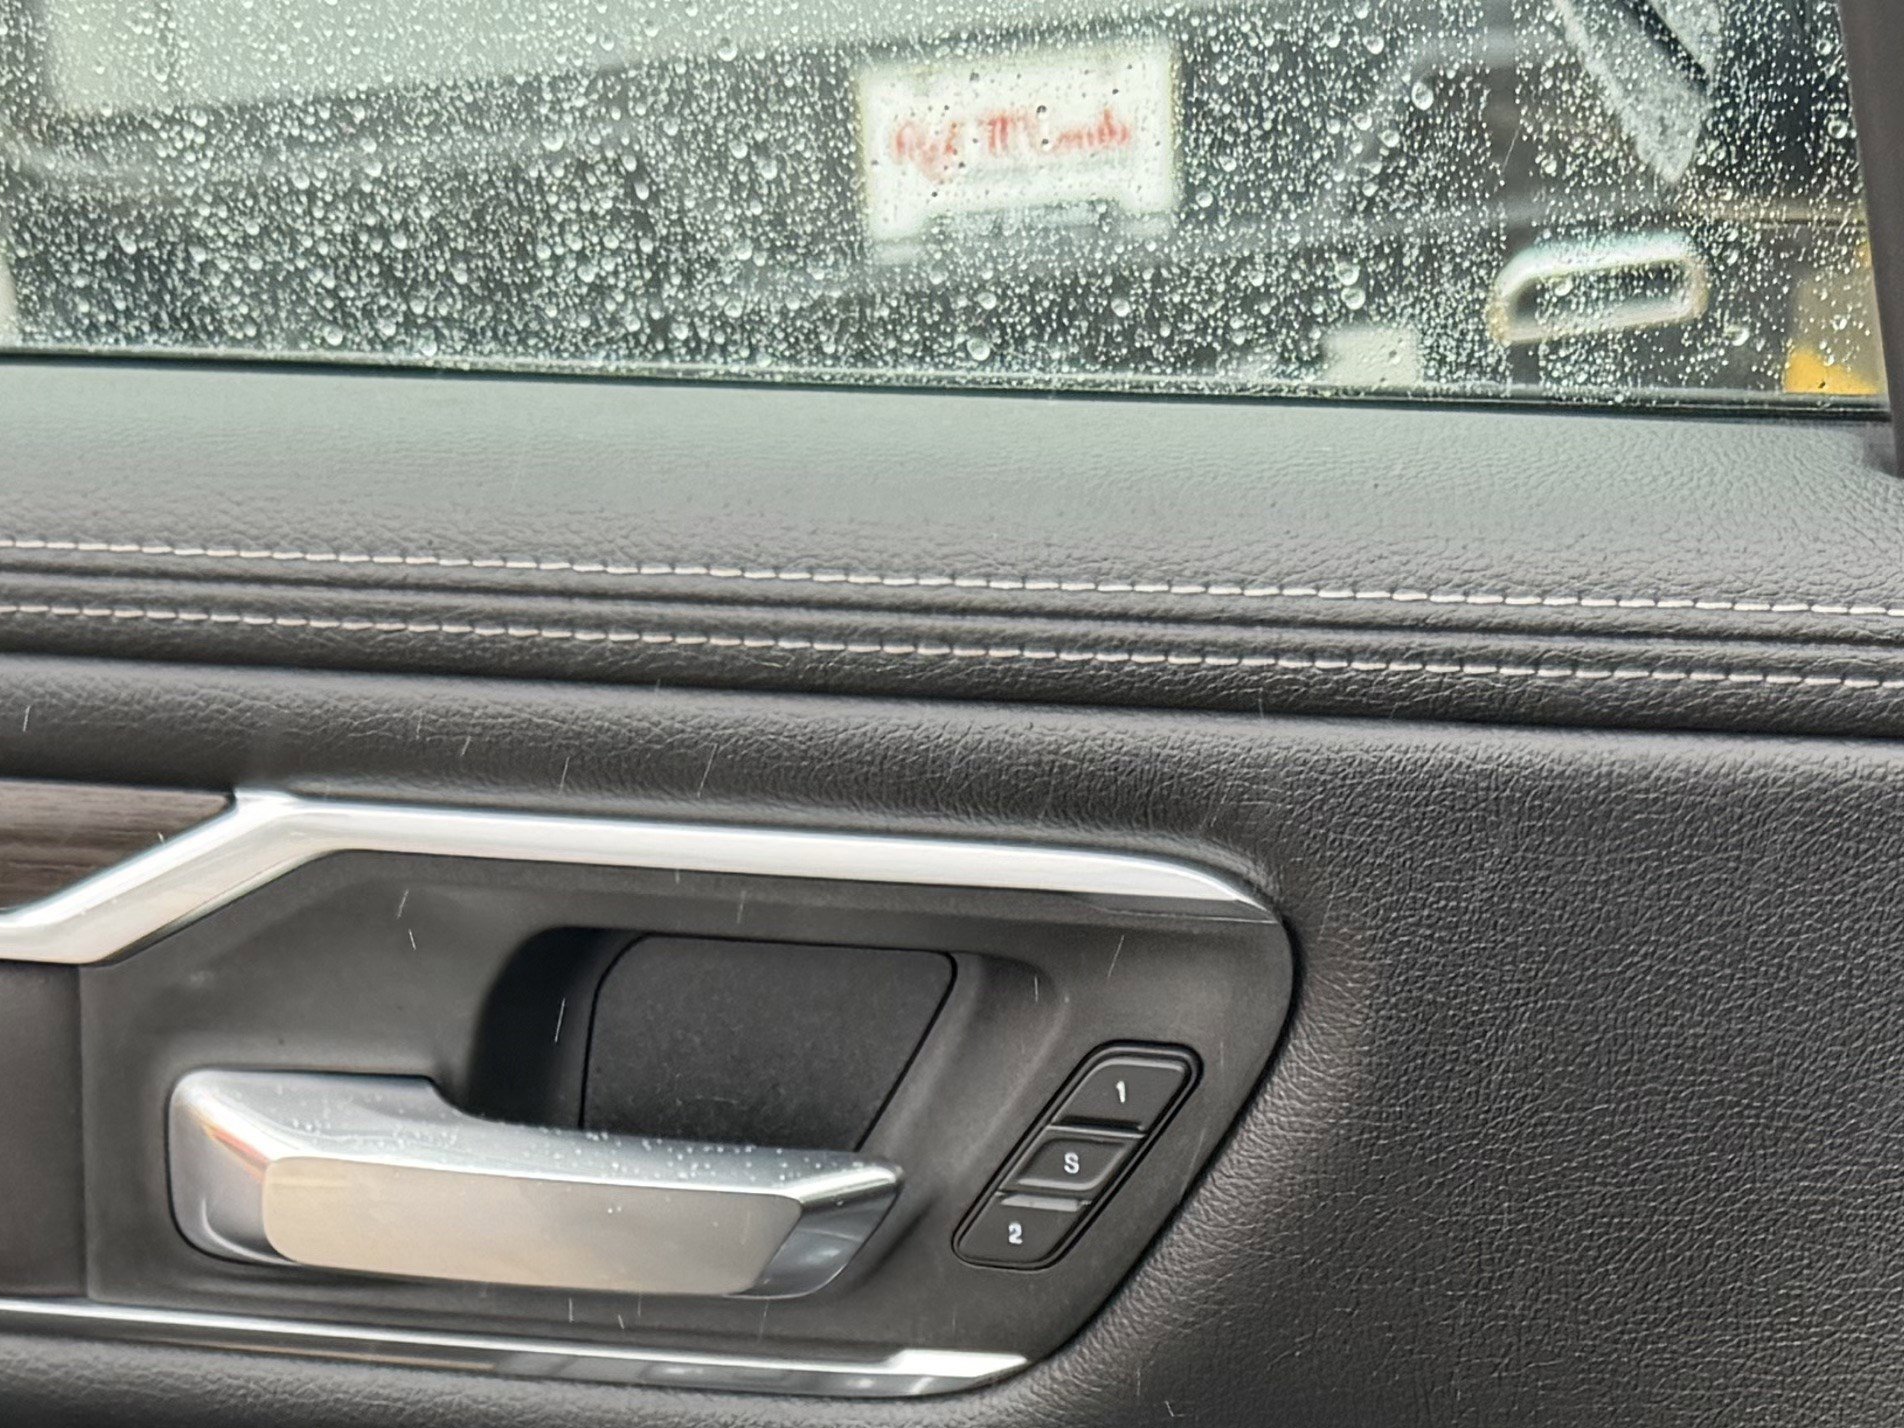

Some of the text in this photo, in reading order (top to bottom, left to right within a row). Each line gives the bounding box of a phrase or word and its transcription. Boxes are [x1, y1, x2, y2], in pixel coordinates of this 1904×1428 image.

[1115, 1080, 1126, 1103] 1
[1063, 1153, 1080, 1174] S
[1007, 1222, 1023, 1244] 2
